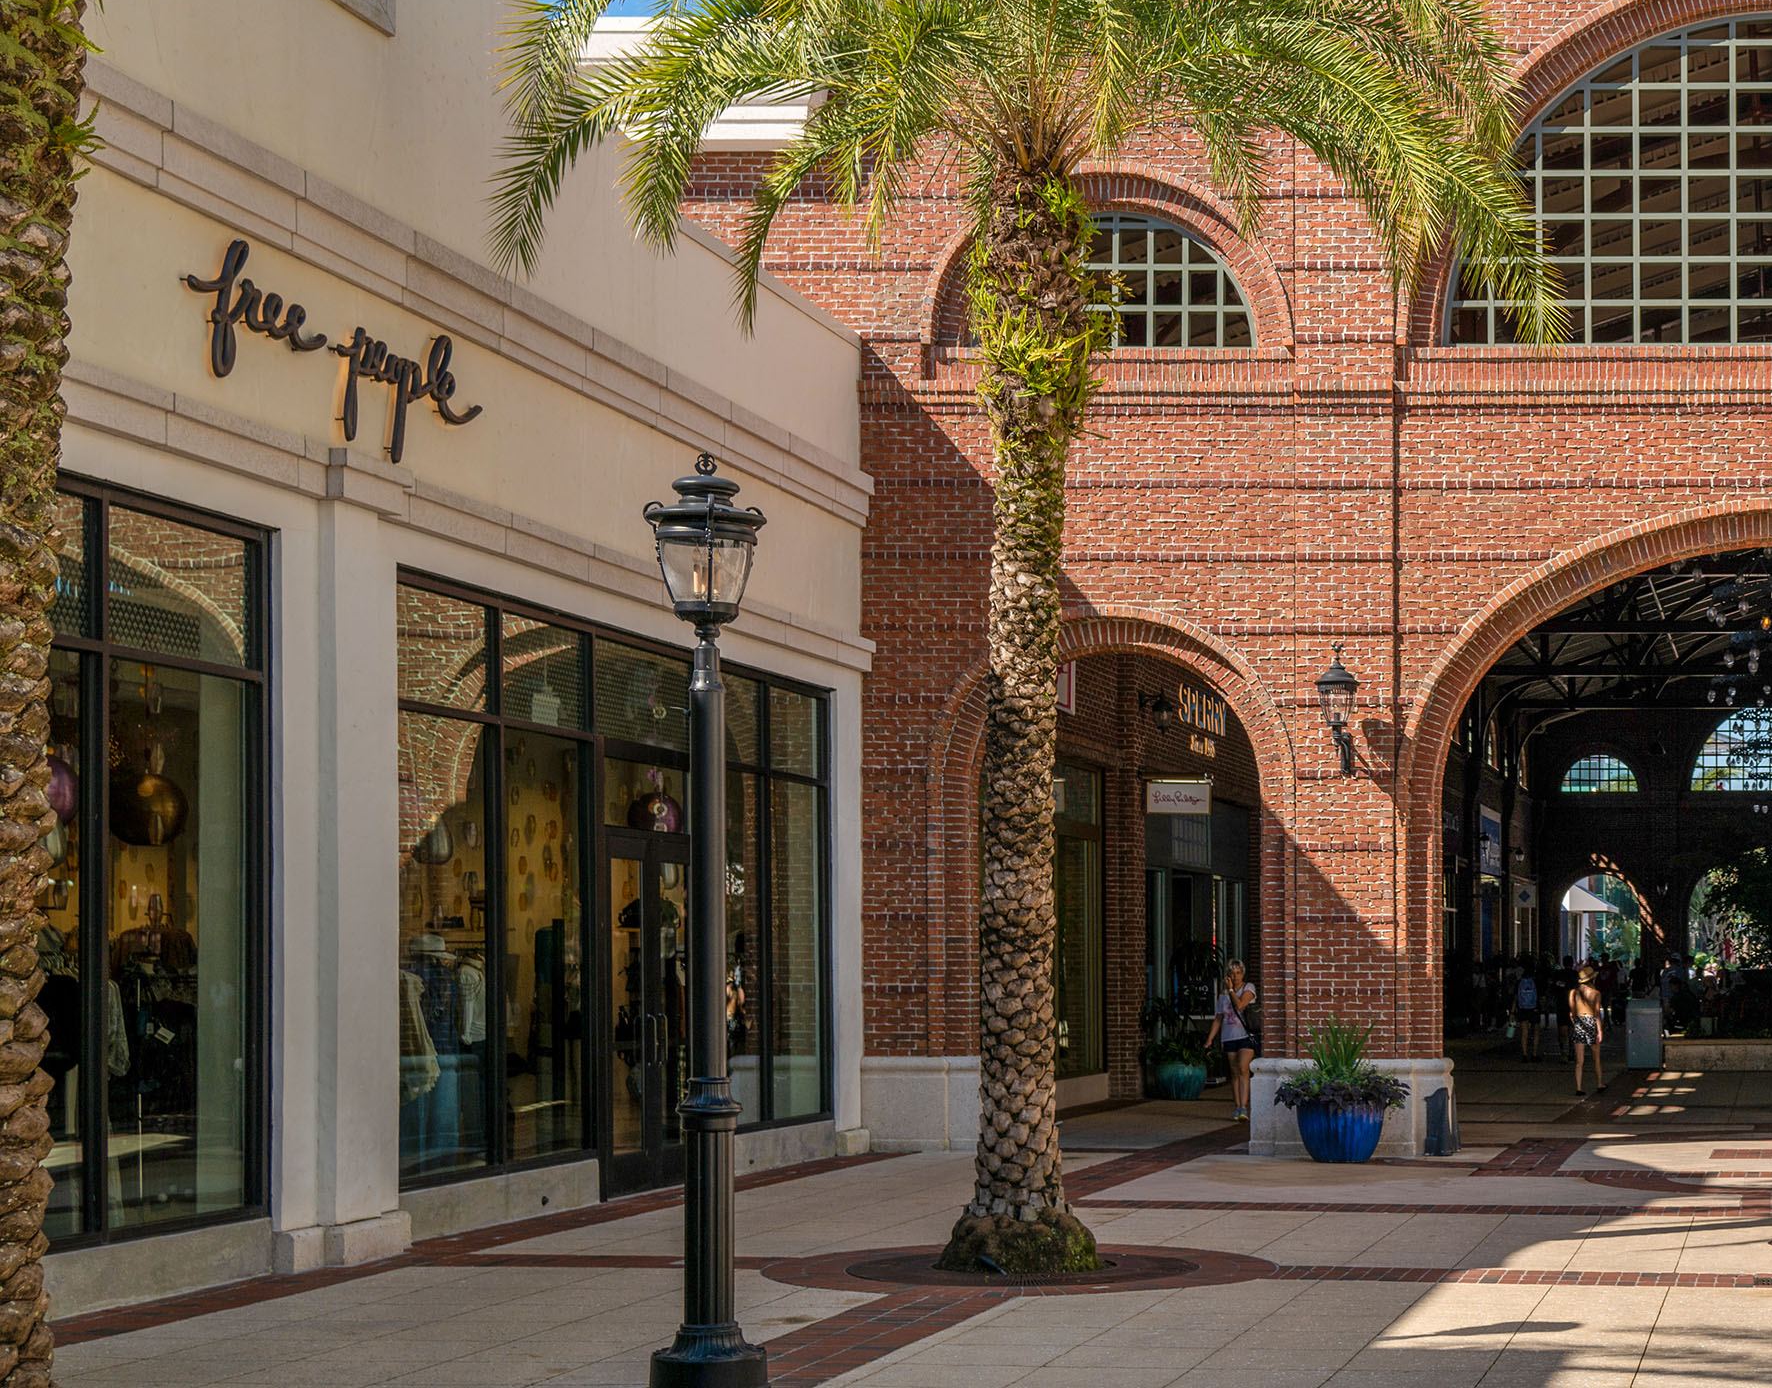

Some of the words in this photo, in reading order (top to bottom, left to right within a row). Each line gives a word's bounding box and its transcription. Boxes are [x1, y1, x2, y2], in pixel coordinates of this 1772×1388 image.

[185, 238, 328, 378] free
[334, 326, 484, 464] people
[1178, 683, 1227, 737] SPERRY
[1152, 790, 1177, 807] Lilly
